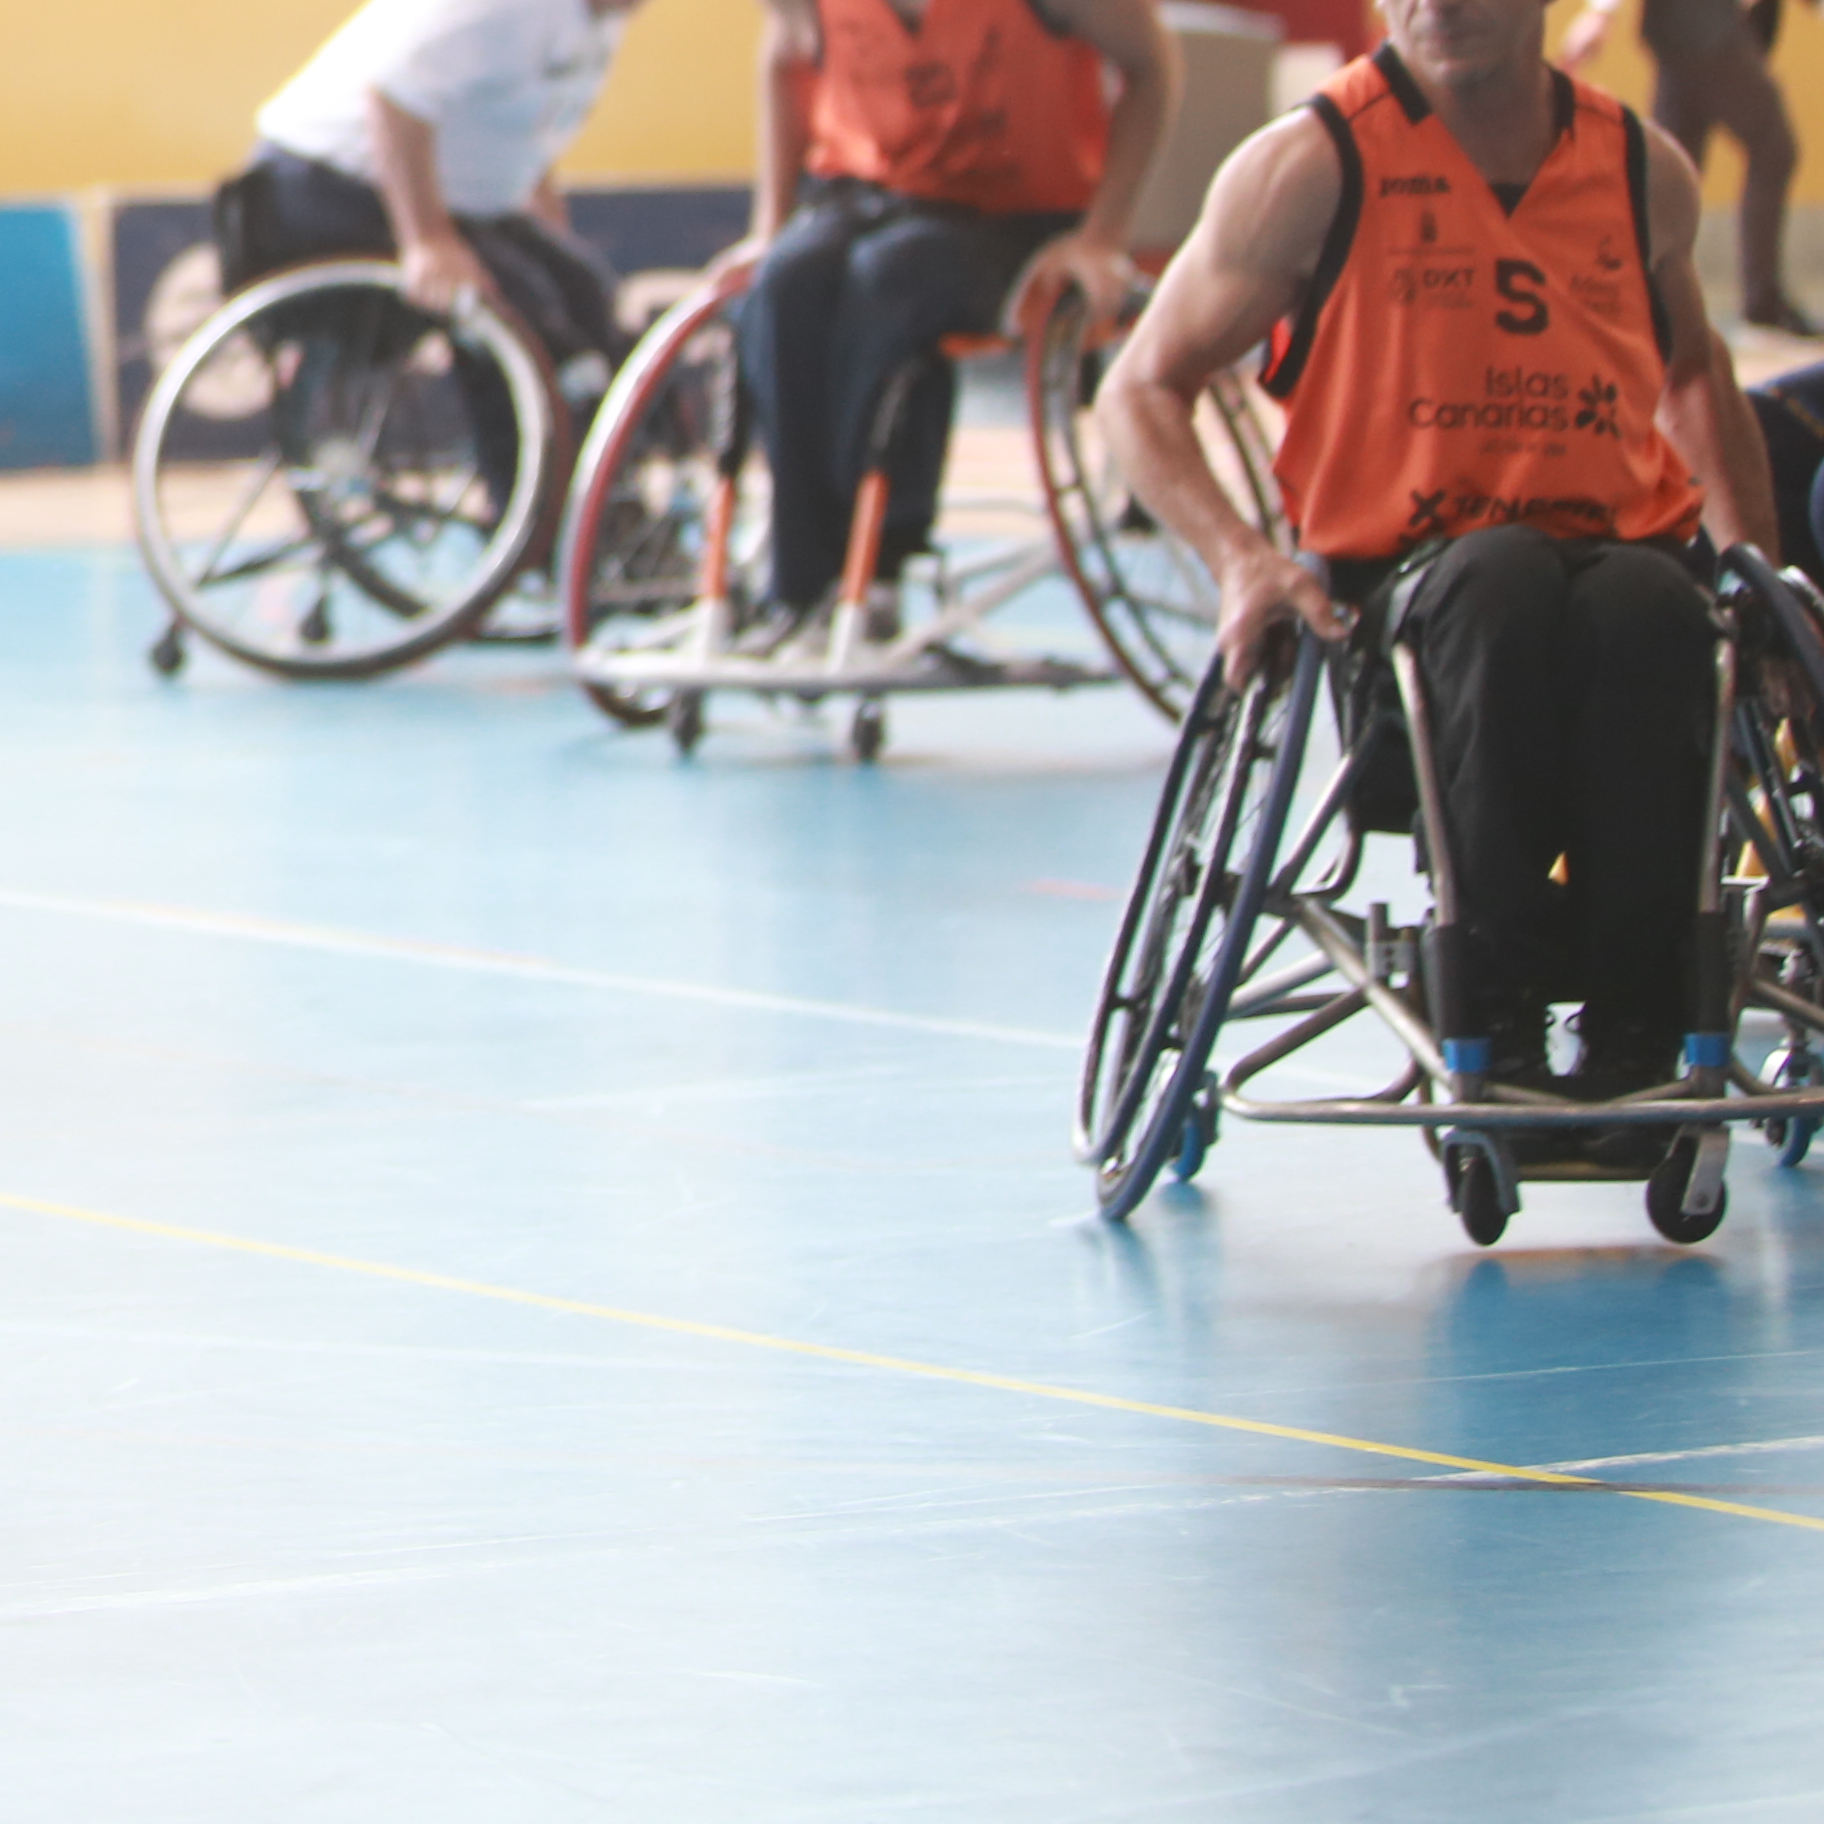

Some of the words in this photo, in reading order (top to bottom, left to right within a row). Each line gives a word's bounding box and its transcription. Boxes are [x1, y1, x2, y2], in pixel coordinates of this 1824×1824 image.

[1494, 258, 1549, 336] 5
[1486, 364, 1570, 400] Islas
[1407, 397, 1570, 432] Canarias
